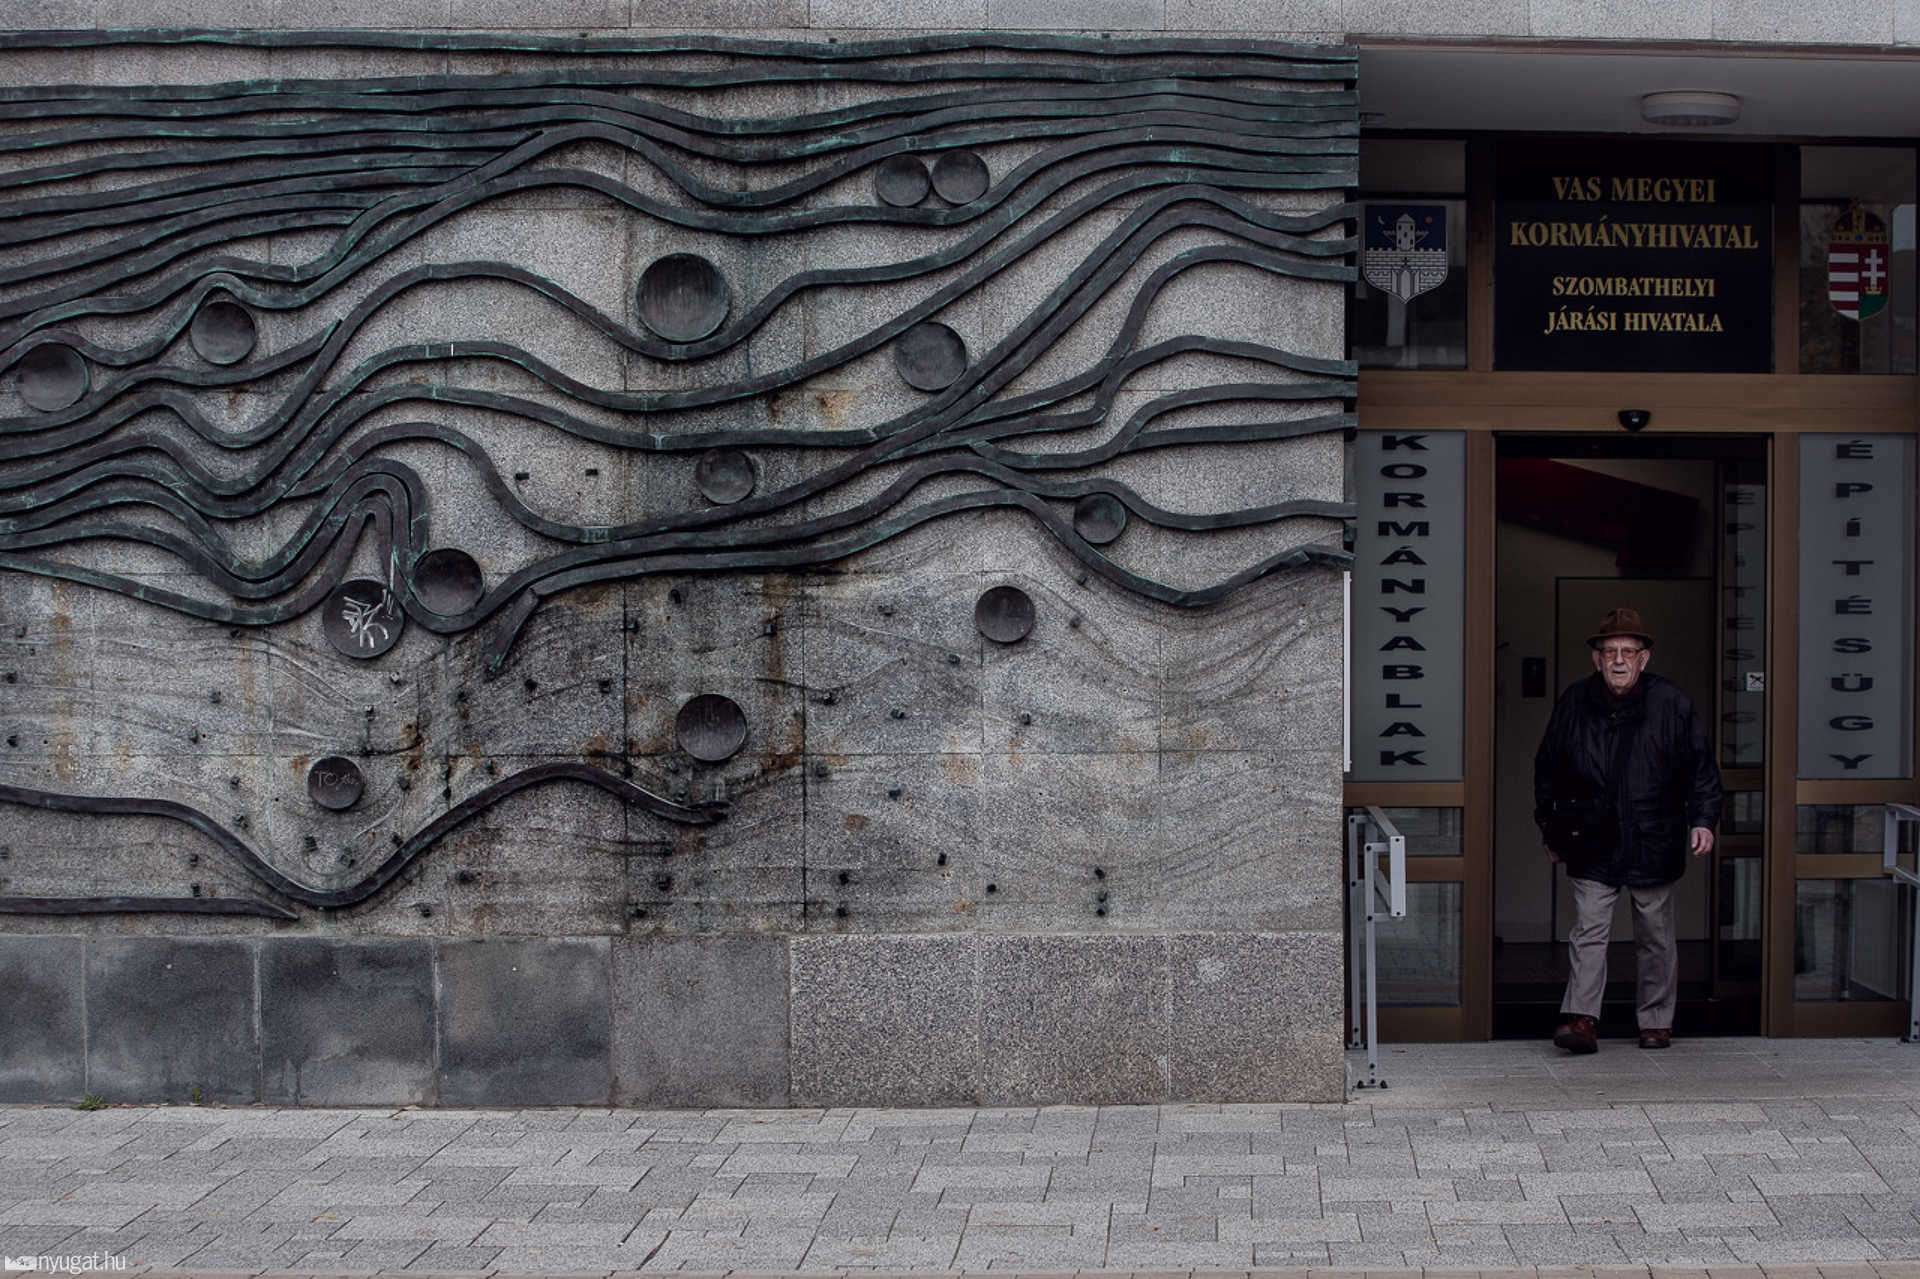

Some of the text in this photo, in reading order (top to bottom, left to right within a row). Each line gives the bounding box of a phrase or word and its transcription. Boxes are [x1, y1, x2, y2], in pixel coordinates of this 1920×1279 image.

[1552, 176, 1717, 203] VAS MEGYEI
[1509, 214, 1759, 249] KORMÁNYHIVATAL
[1552, 276, 1717, 298] SZOMBATHELYI
[1543, 304, 1724, 335] JÁRÁSI HIVATALA
[1378, 435, 1429, 766] KORMÁNYABLAK
[1830, 440, 1875, 770] ÉPÍTÉSÜGY
